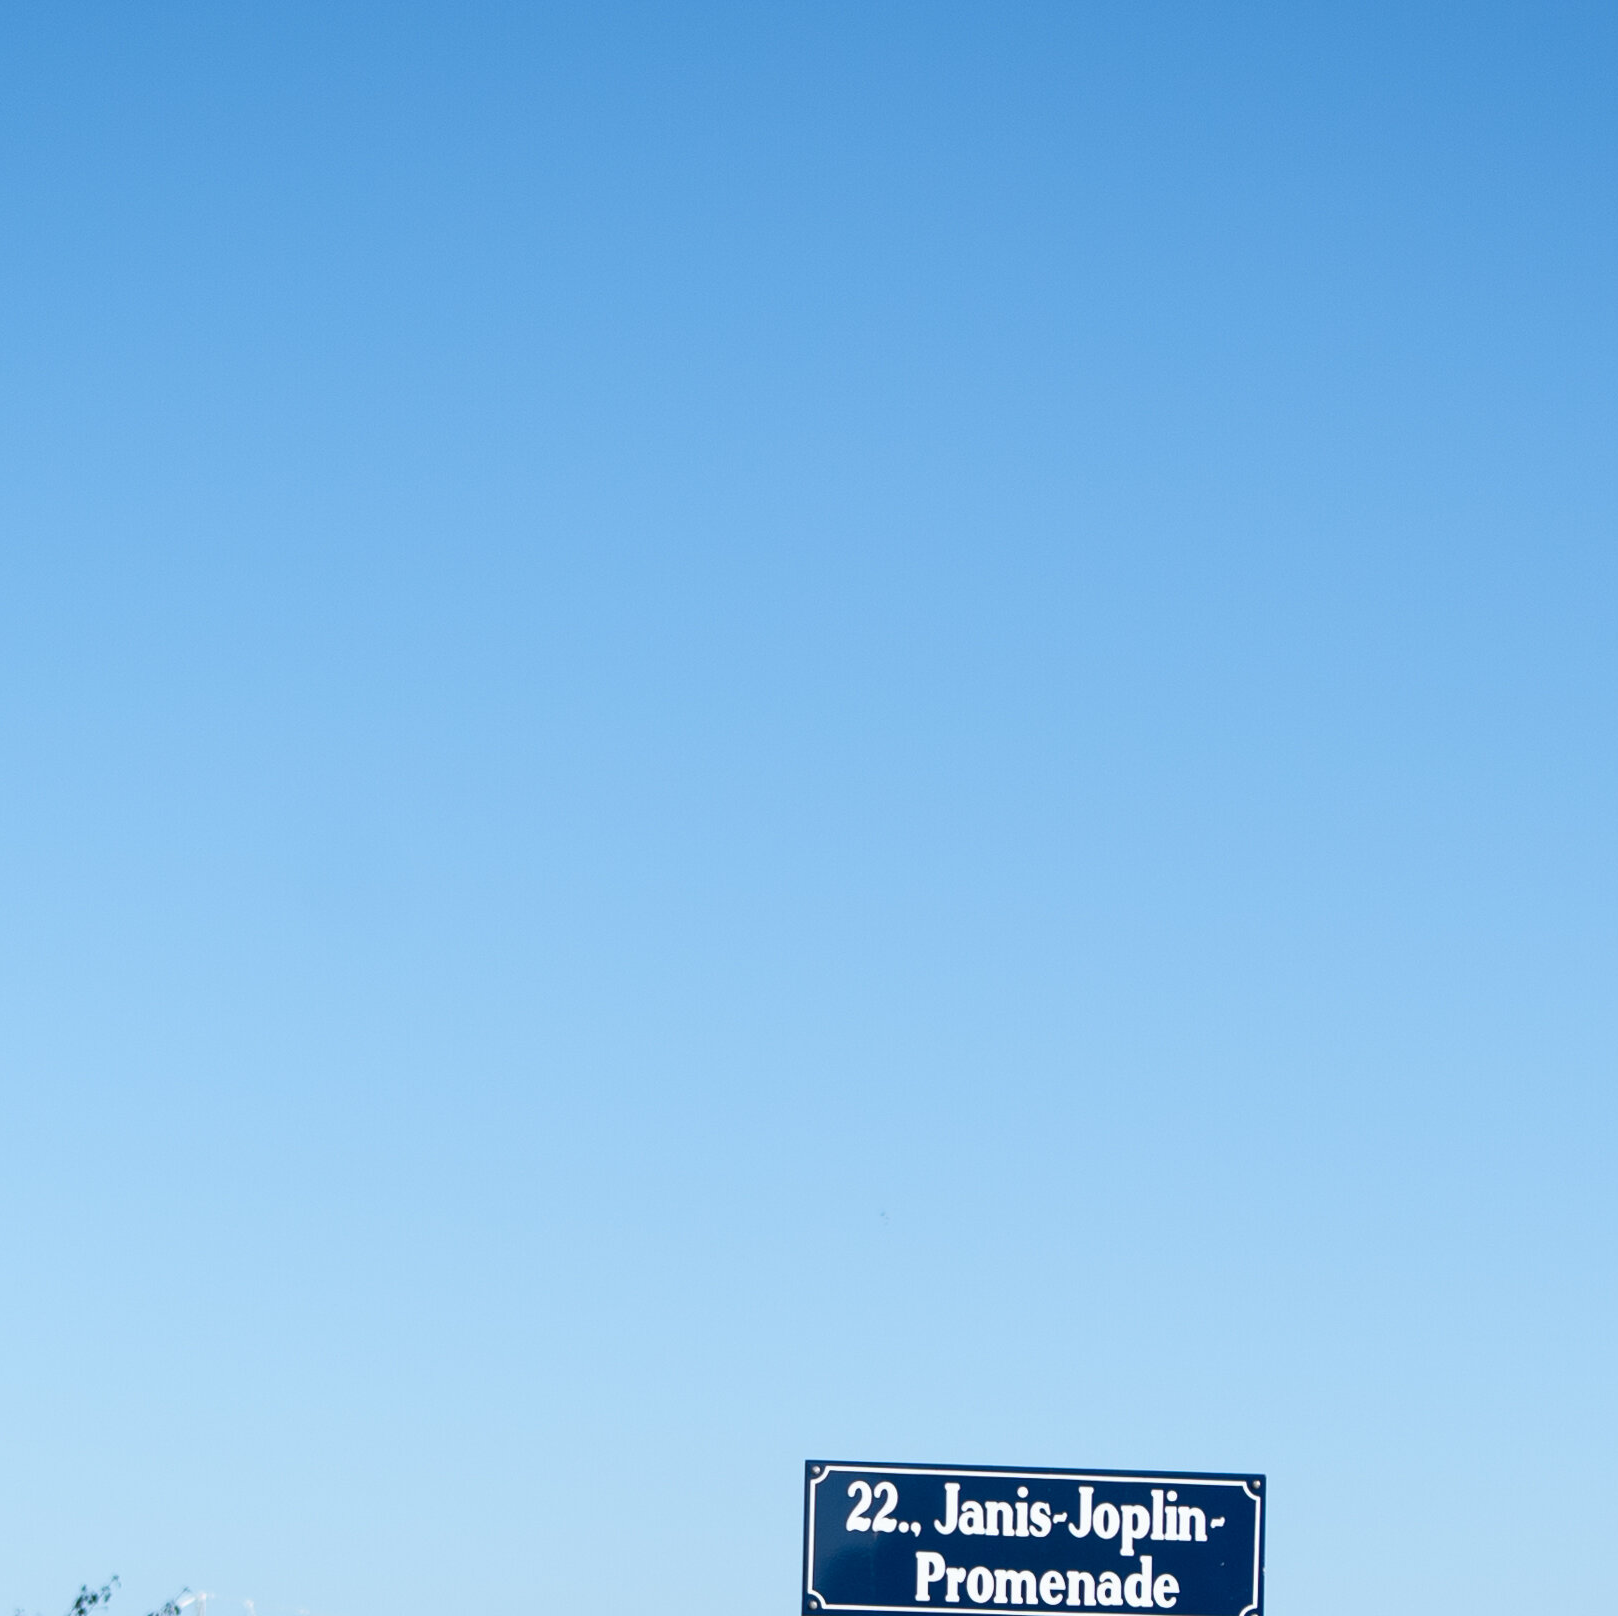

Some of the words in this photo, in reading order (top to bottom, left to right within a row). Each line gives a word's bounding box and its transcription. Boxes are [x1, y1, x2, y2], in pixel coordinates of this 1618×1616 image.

[845, 1480, 922, 1538] 22.,
[933, 1481, 1226, 1557] Janis-Joplin-
[914, 1551, 1181, 1608] Promenade
